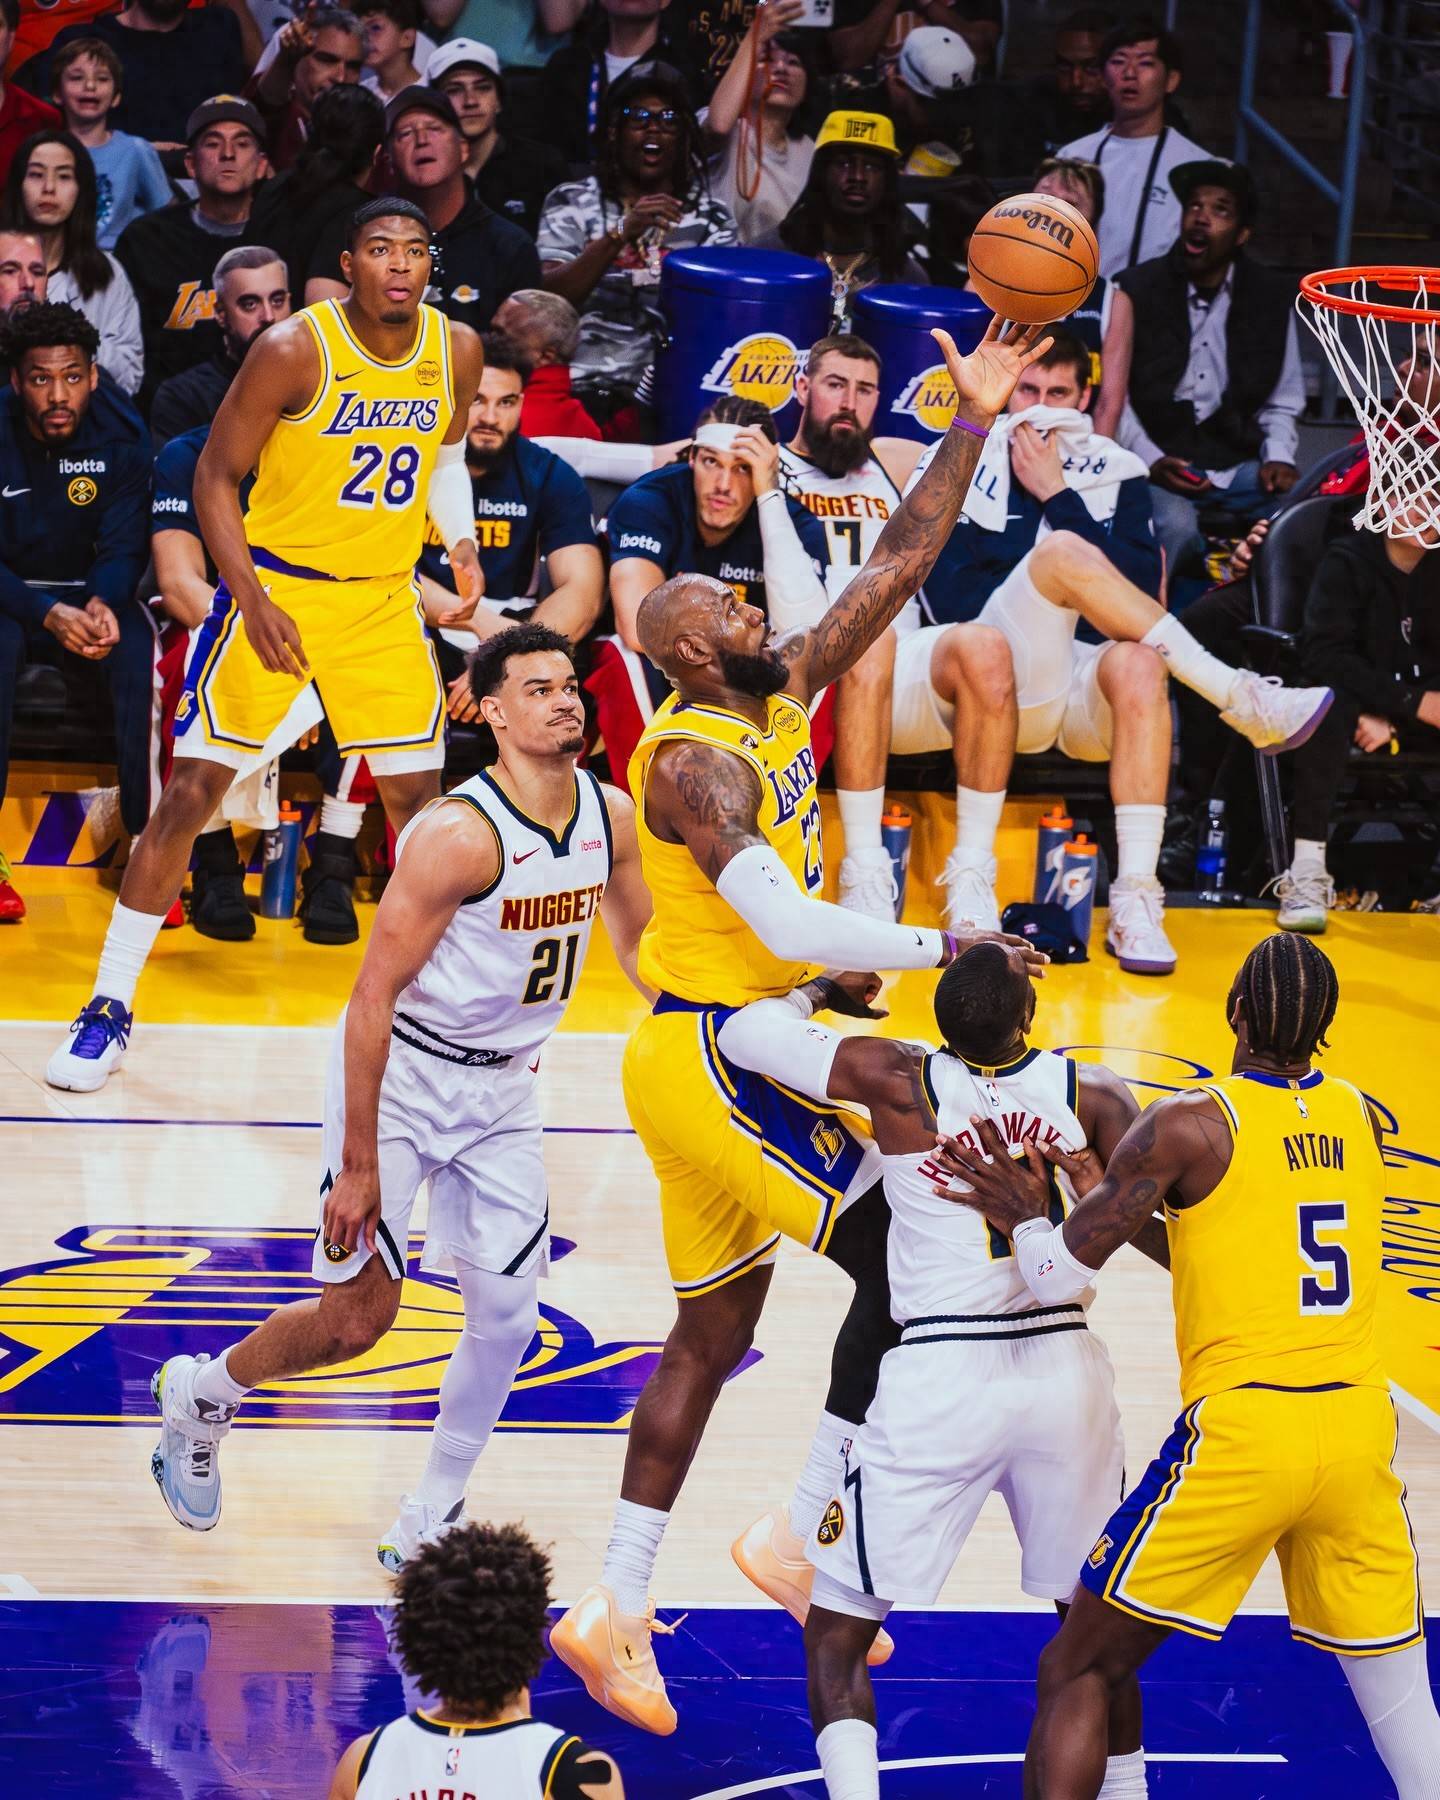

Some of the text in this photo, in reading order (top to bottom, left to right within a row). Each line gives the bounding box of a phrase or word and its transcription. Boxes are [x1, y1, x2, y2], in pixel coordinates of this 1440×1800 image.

[993, 207, 1075, 250] Wilson
[320, 393, 440, 435] LAKERS
[59, 459, 106, 474] ibotta
[339, 444, 421, 508] 28
[478, 499, 528, 517] ibotta
[619, 533, 662, 554] ibotta
[580, 839, 602, 852] ibotta
[521, 934, 580, 1005] 21
[1282, 1132, 1345, 1172] AYTON
[1298, 1202, 1351, 1309] 5
